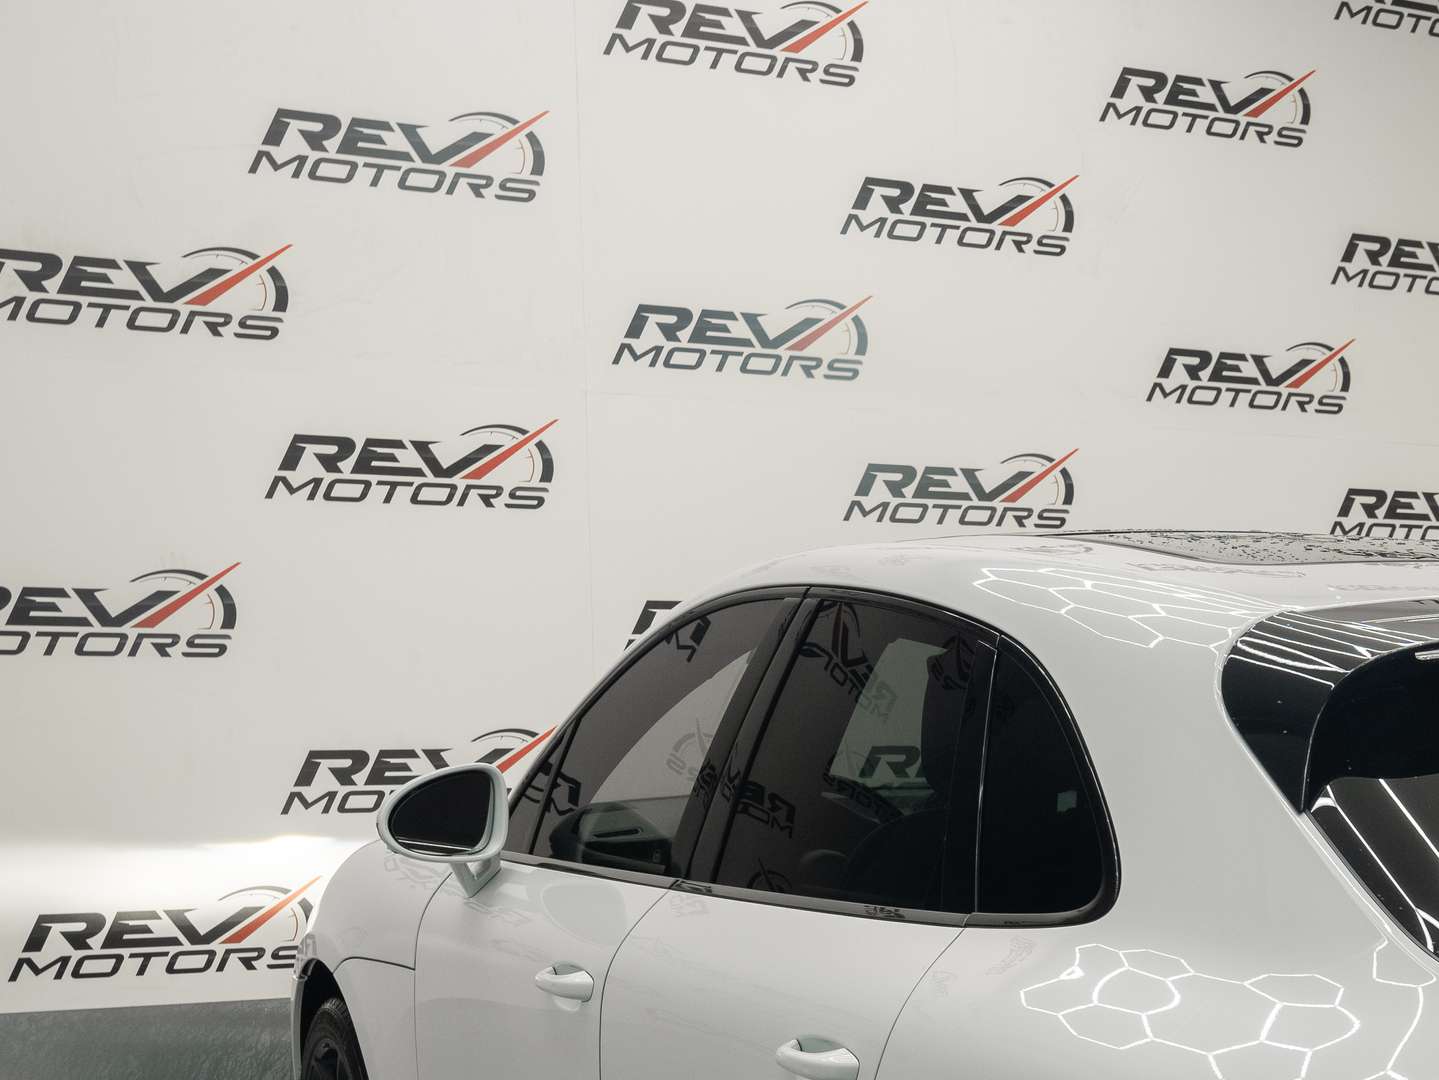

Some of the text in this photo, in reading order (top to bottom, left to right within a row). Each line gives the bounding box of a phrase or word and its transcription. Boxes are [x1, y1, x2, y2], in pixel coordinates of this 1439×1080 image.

[616, 0, 821, 50] REV
[604, 33, 859, 87] MOTORS
[1110, 67, 1276, 116] REV
[262, 108, 495, 165] REV
[1099, 102, 1306, 149] MOTORS
[248, 150, 540, 203] MOTORS
[852, 177, 1035, 225] REV
[840, 214, 1069, 257] MOTORS
[0, 249, 234, 304] REV
[624, 304, 823, 350] REV
[612, 343, 859, 381] MOTORS
[1156, 348, 1317, 388] REV
[1146, 382, 1346, 415] MOTORS
[278, 434, 505, 479] REV
[265, 476, 549, 510] MOTORS
[855, 464, 1035, 503] REV
[844, 501, 1069, 530] MOTORS
[0, 586, 181, 628] EV
[21, 905, 266, 953] REV
